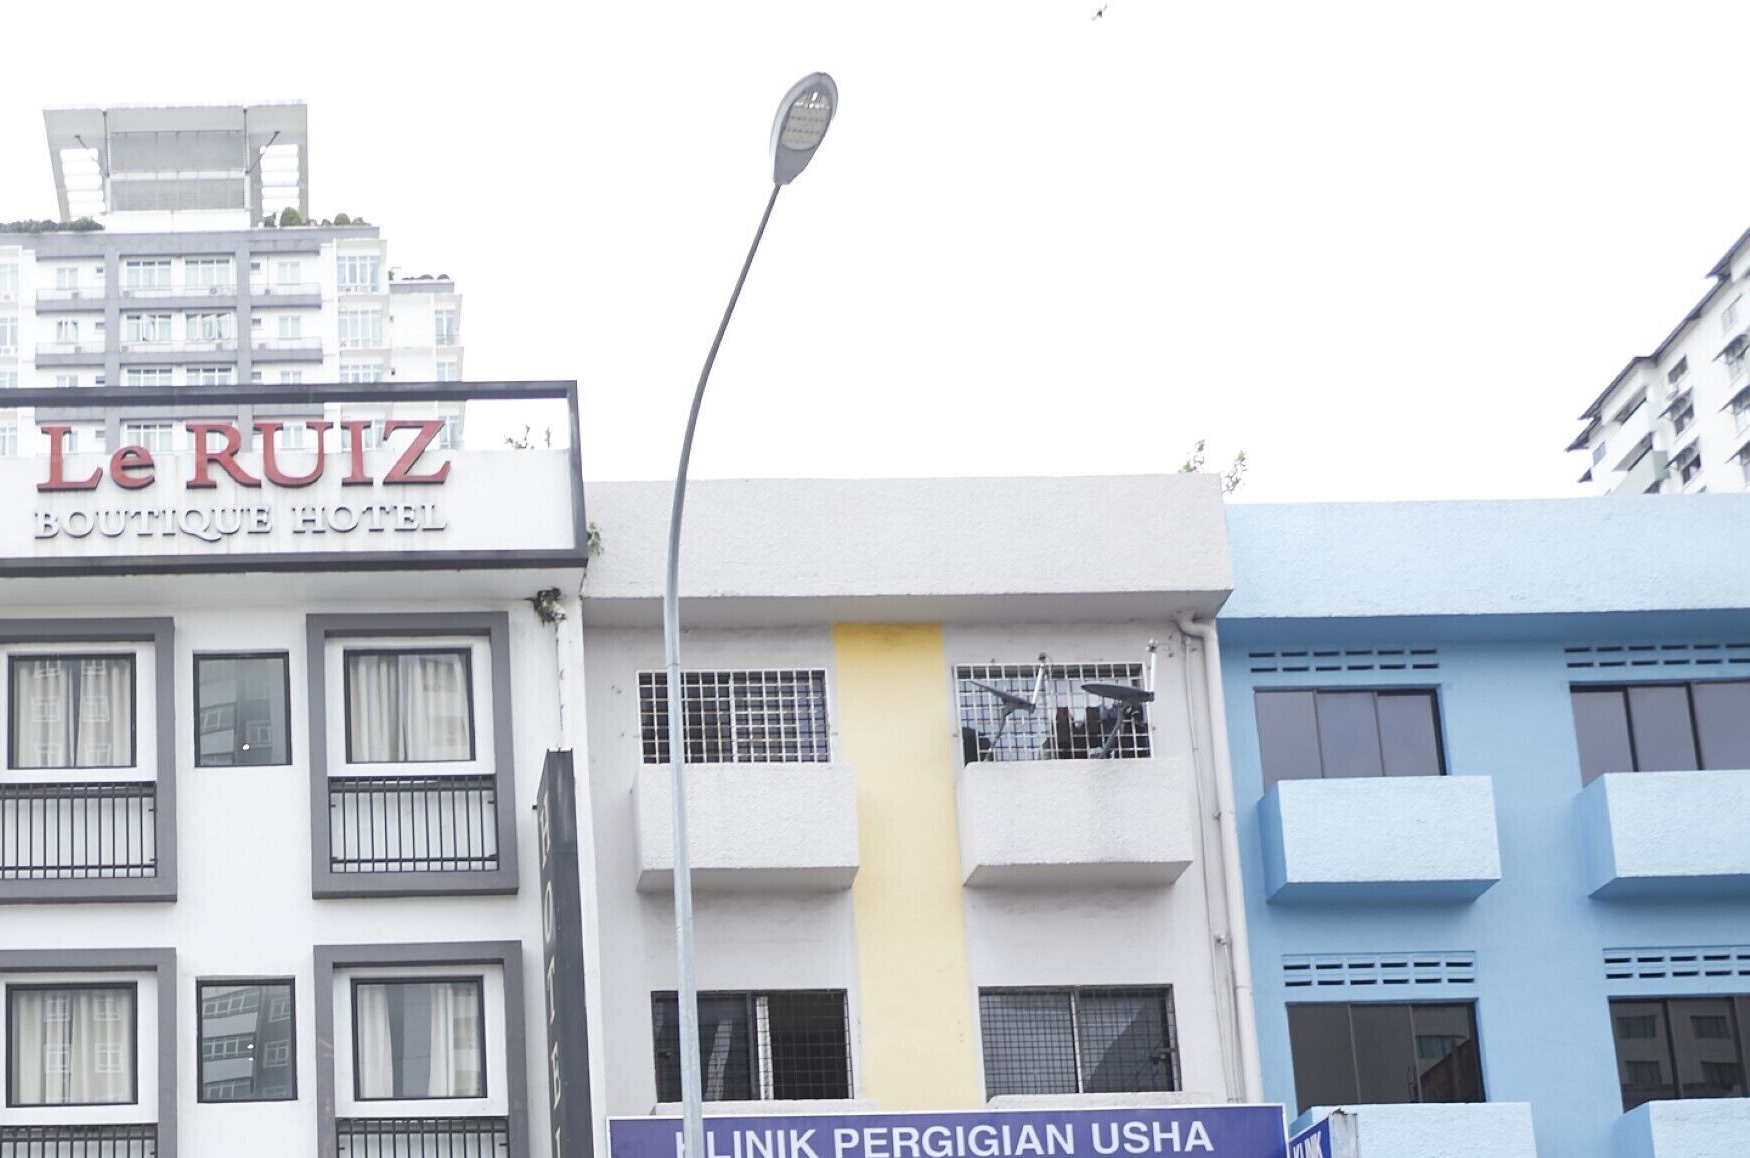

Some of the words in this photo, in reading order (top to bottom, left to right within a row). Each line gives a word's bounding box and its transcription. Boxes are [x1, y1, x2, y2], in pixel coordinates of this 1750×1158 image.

[36, 425, 155, 494] Le
[185, 419, 452, 490] RUIZ
[34, 506, 273, 542] BOUTIQUE
[291, 503, 448, 535] HOTEL
[1091, 1120, 1214, 1155] USHA
